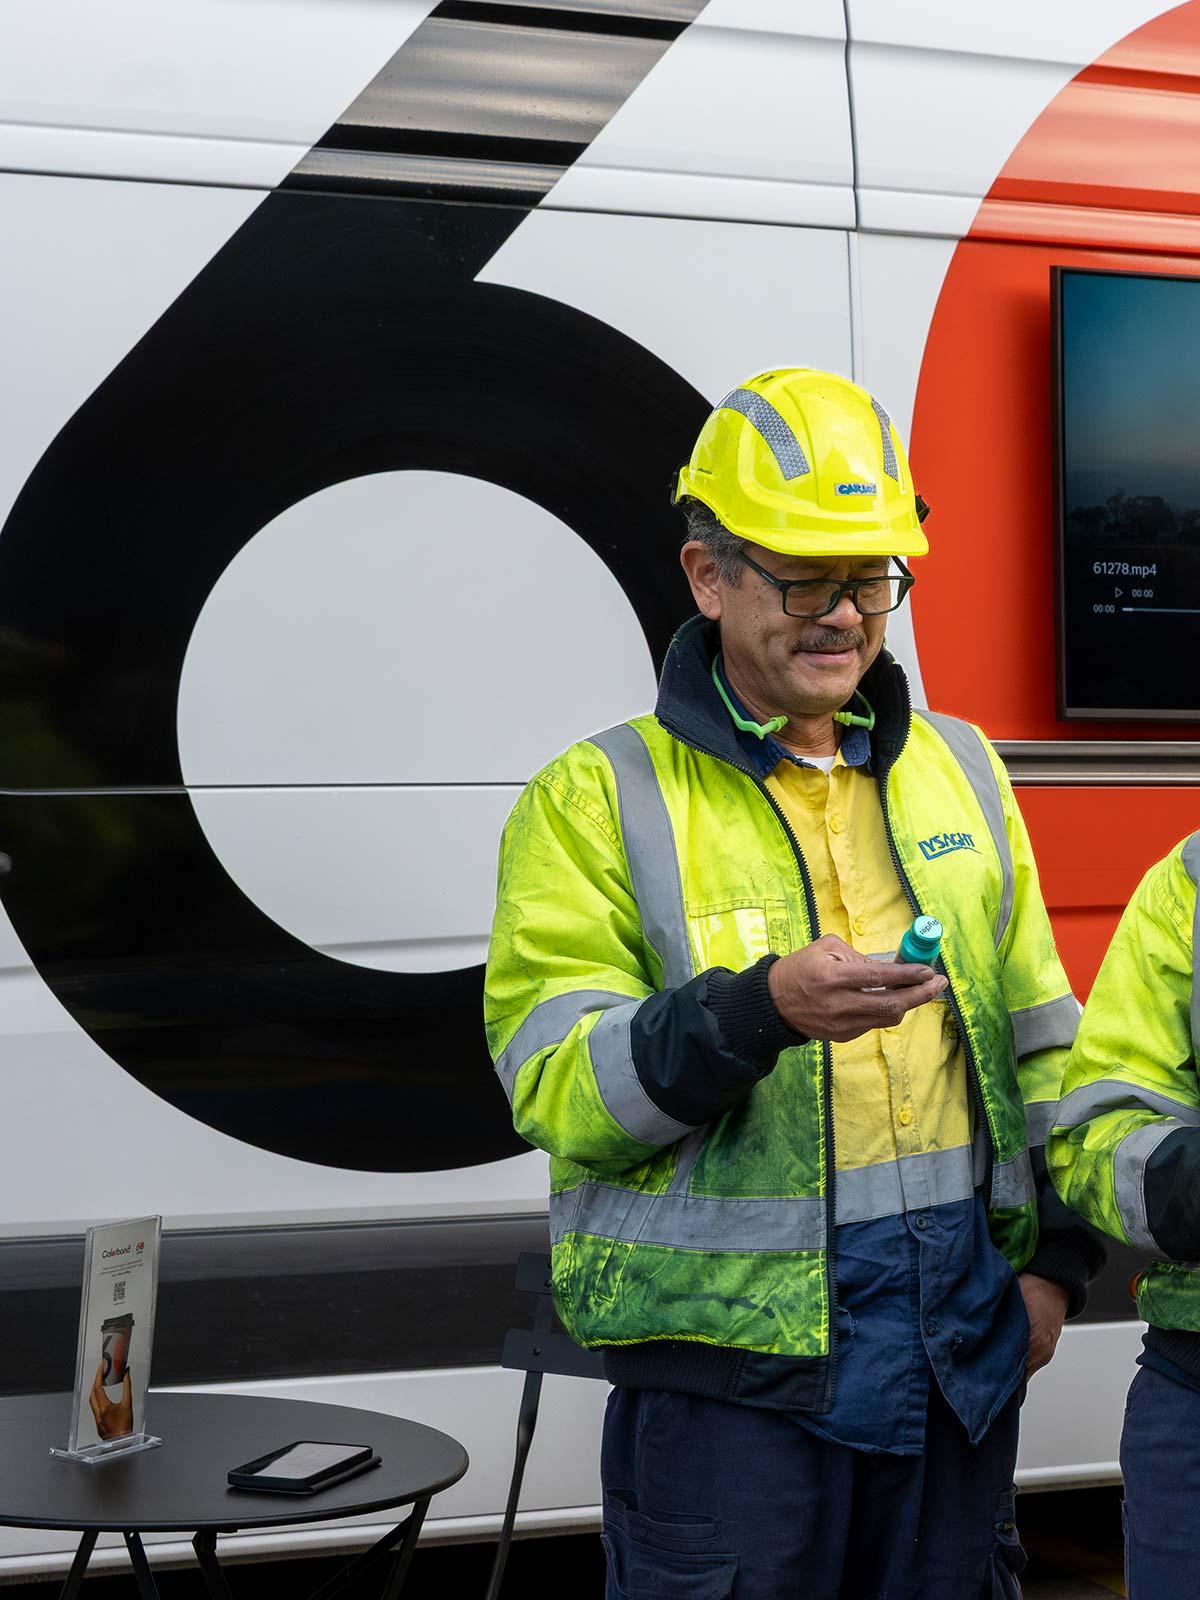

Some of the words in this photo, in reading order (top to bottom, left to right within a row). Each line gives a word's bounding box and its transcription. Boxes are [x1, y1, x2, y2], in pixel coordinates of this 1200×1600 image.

[1093, 561, 1157, 579] 61278.mp4
[1131, 588, 1154, 598] 00:00
[1093, 603, 1115, 613] 00:00
[917, 832, 976, 860] LYSAGHT
